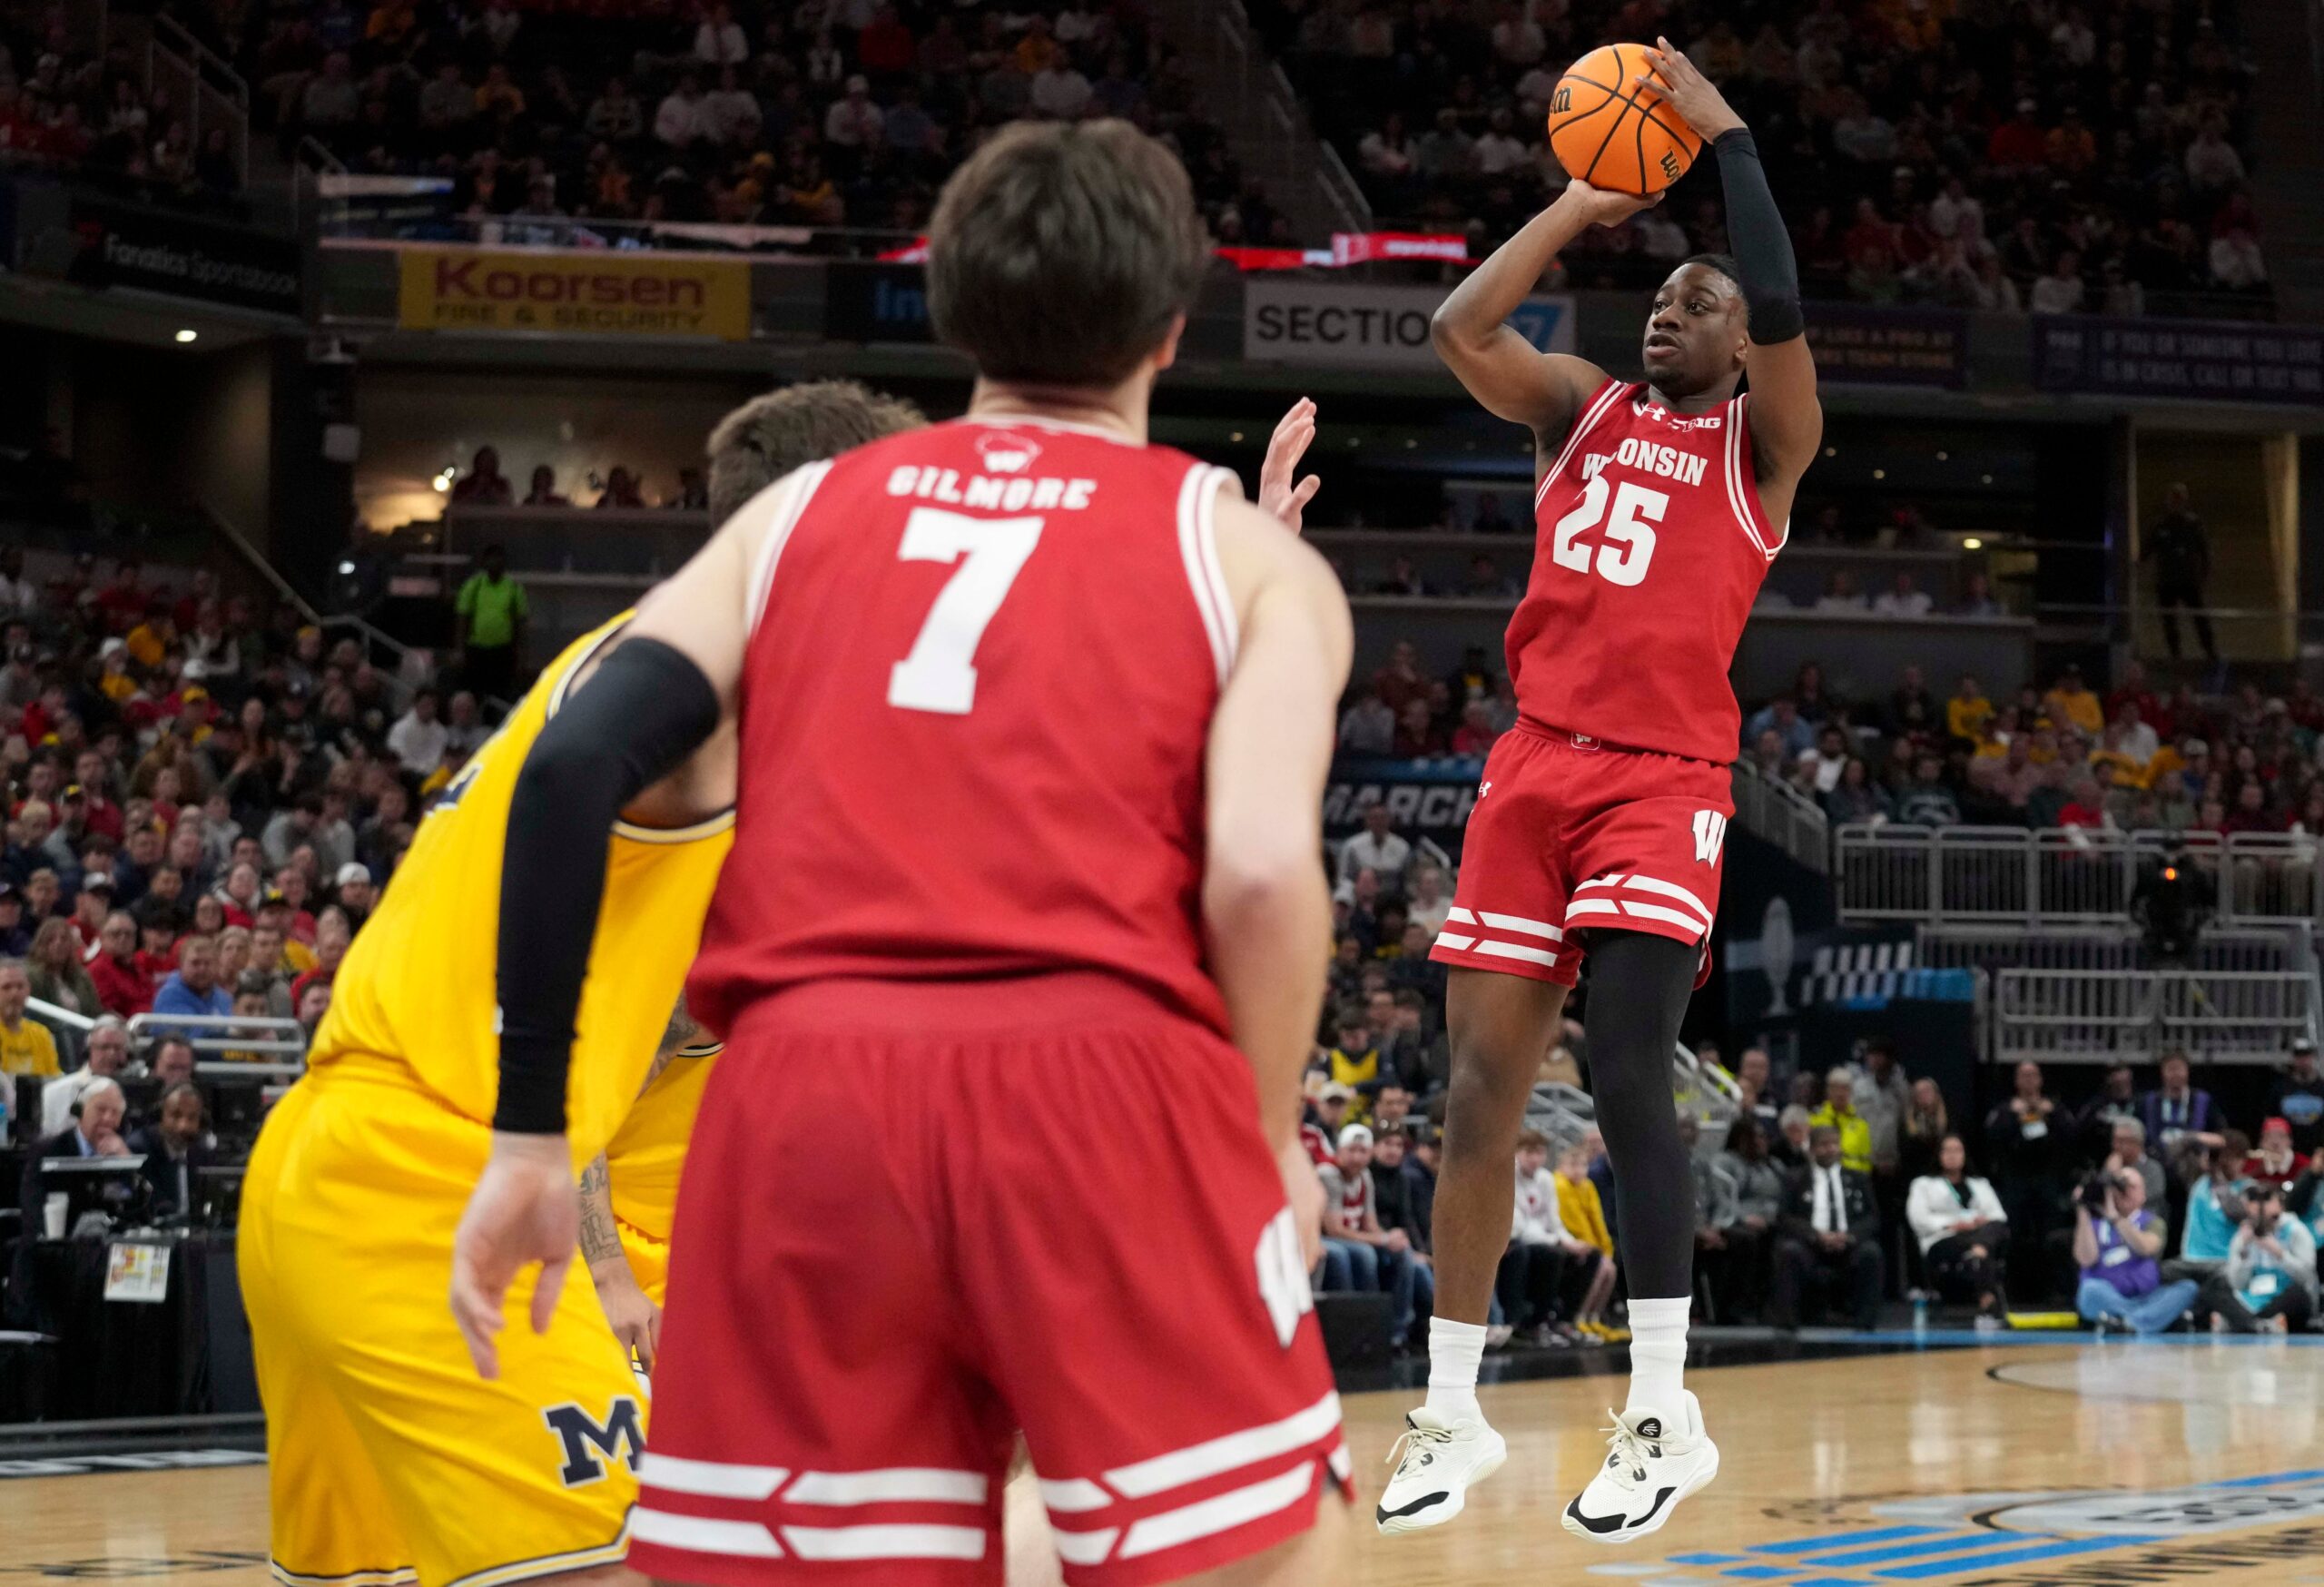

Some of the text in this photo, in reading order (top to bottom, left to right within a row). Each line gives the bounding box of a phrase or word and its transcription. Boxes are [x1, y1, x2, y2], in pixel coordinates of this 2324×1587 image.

[105, 233, 189, 277] Fanatics
[435, 257, 704, 305] Koorsen
[435, 303, 704, 329] FIRE & SECURITY
[1256, 305, 1430, 346] SECTIO
[1581, 438, 1709, 488] WONSIN
[887, 465, 1098, 511] GILMORE
[1552, 475, 1670, 586] 25
[887, 505, 1046, 715] 7
[1690, 809, 1728, 870] W
[540, 1395, 646, 1488] M
